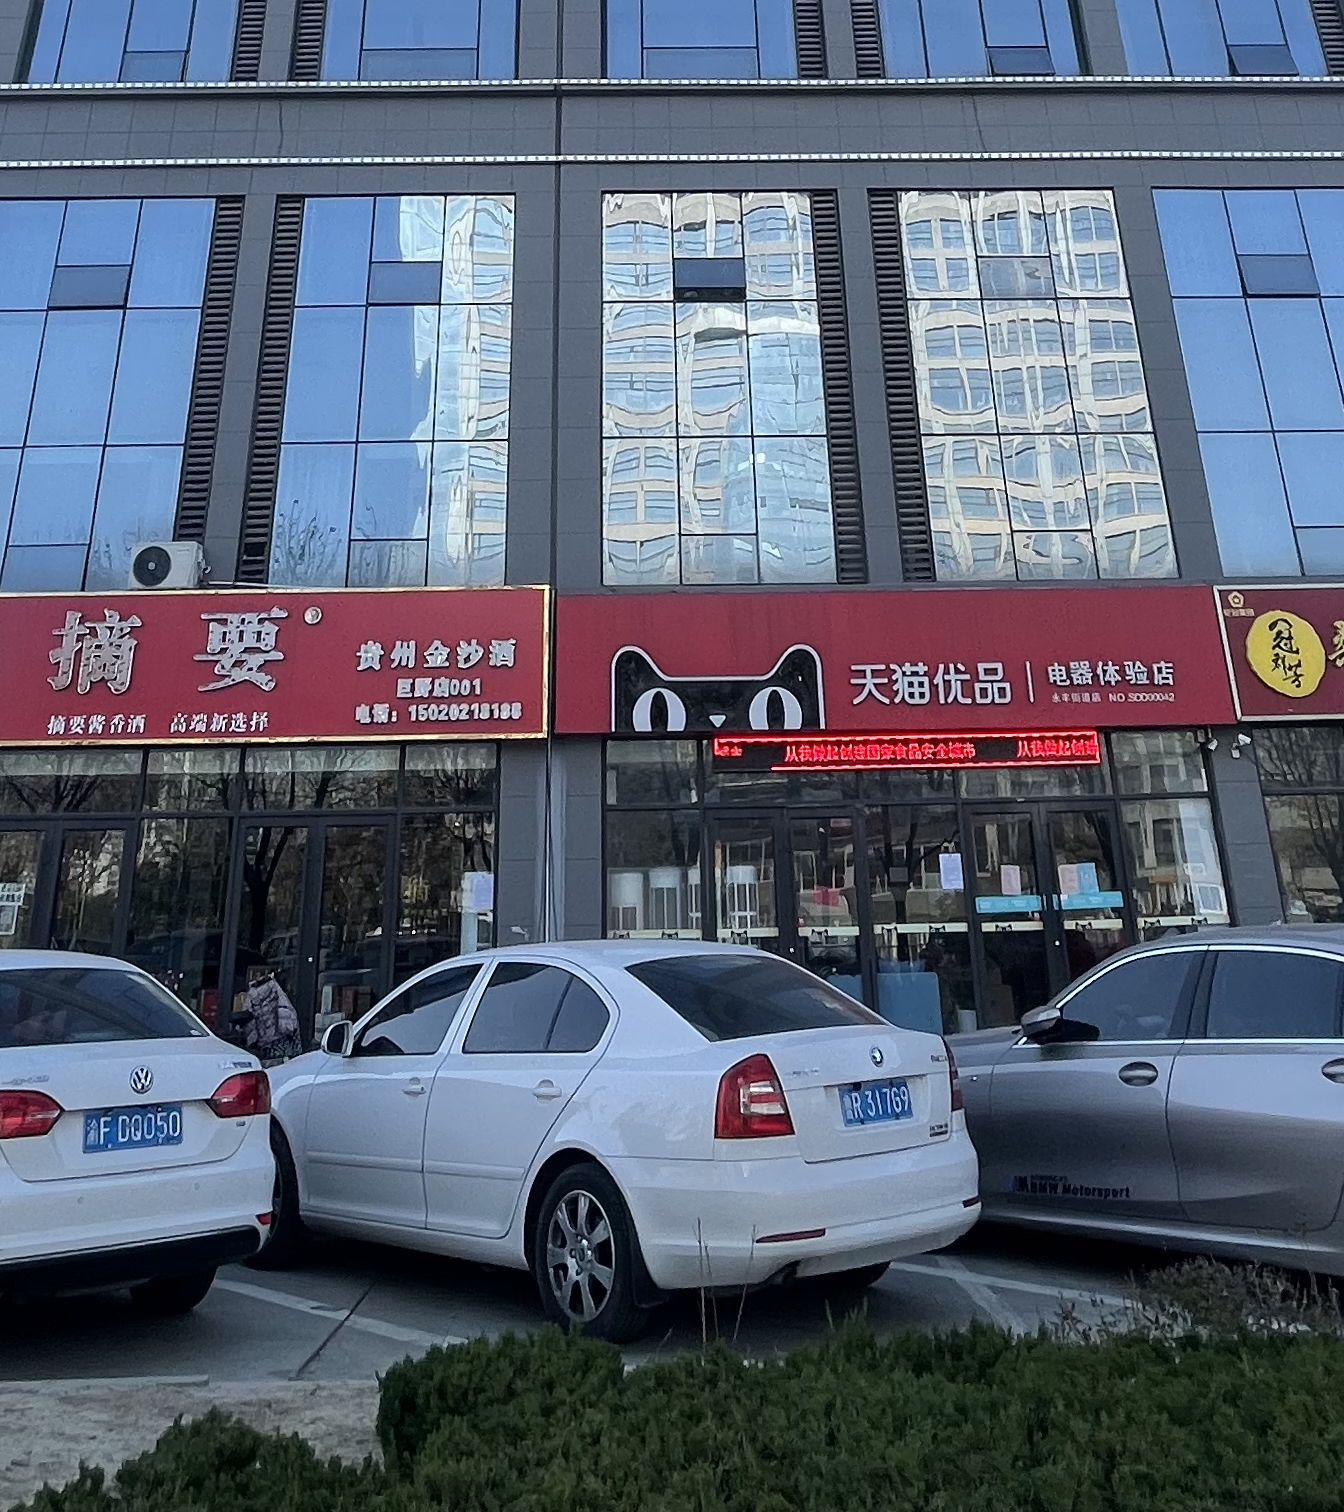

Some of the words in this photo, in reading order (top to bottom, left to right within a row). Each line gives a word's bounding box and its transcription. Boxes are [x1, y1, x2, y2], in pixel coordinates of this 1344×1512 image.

[47, 606, 289, 694] 摘要
[356, 638, 517, 671] 贵州金沙酒
[850, 662, 1013, 705] 天猫优品
[1047, 660, 1175, 686] 电器体验店
[170, 711, 270, 734] 高端新选择
[1062, 1183, 1130, 1199] Motorsport
